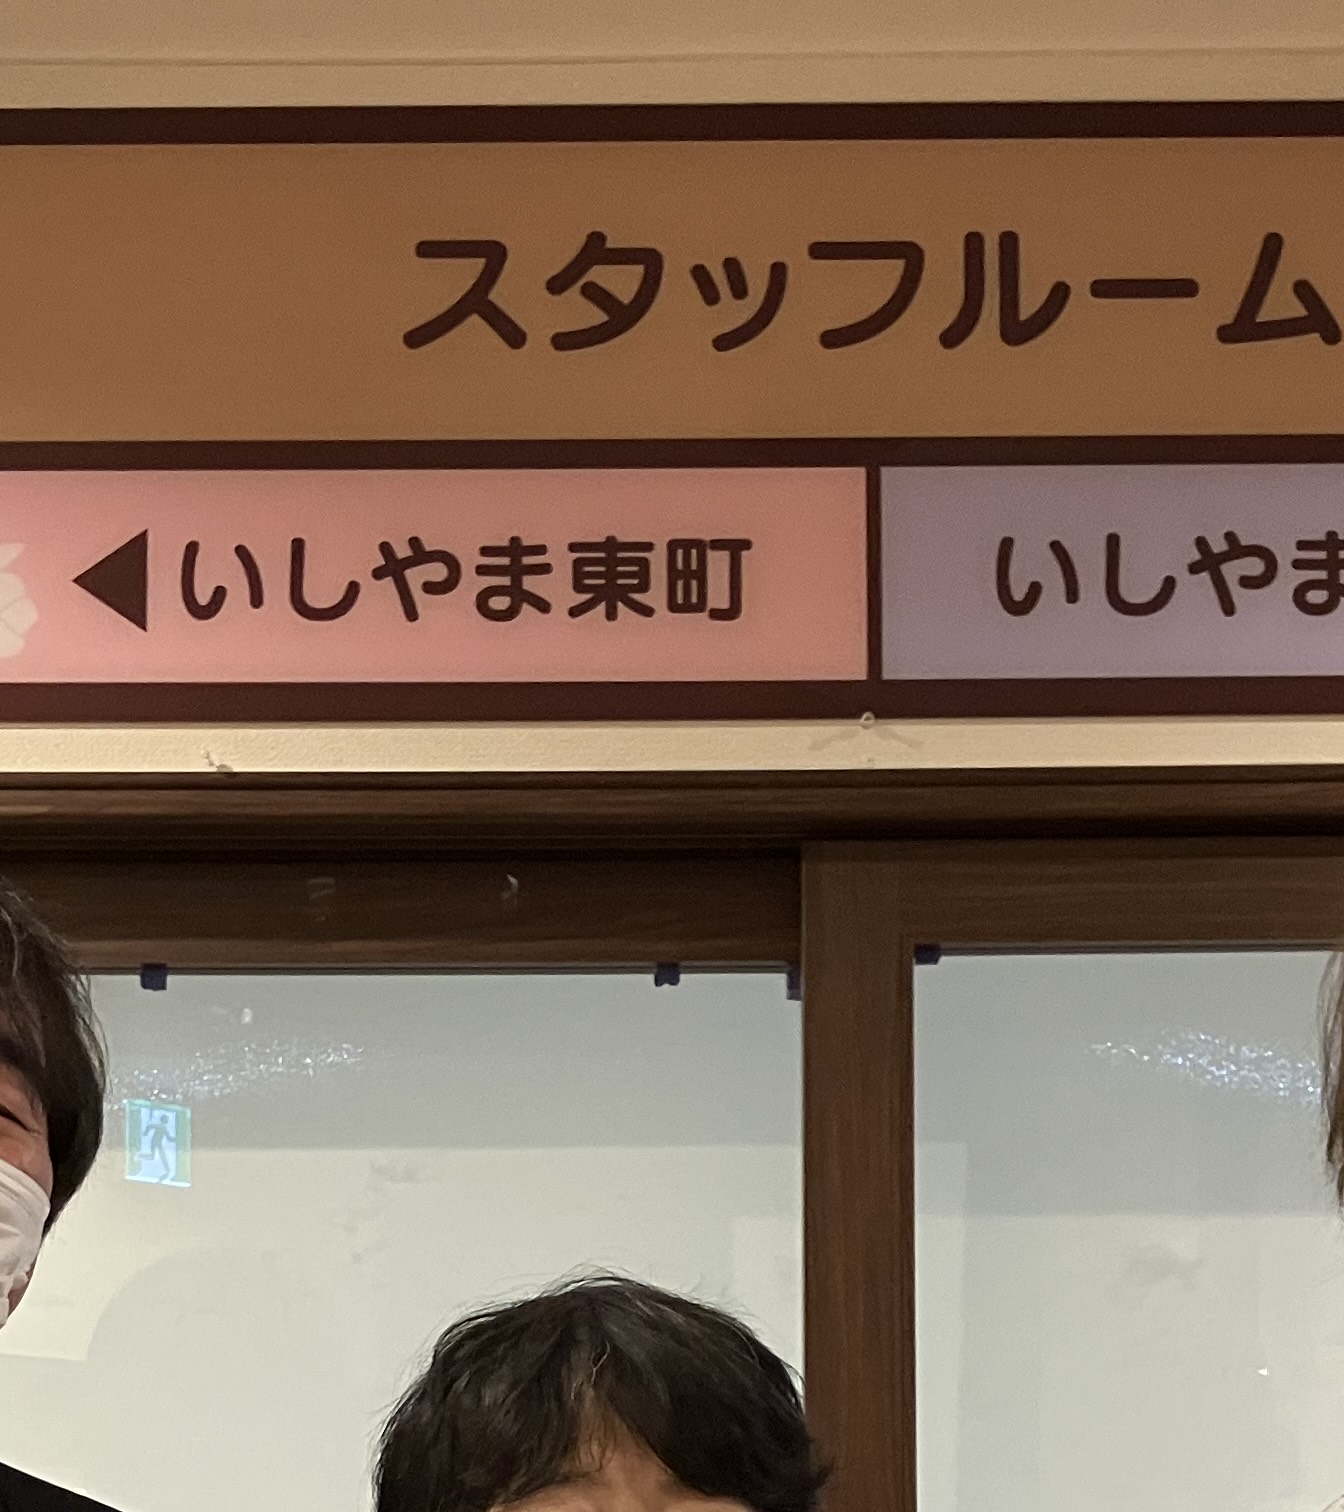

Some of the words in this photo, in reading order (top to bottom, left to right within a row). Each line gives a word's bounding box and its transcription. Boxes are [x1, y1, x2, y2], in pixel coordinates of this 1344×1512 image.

[402, 229, 1343, 352] スタッフルーム
[180, 534, 753, 623] いしやま東町
